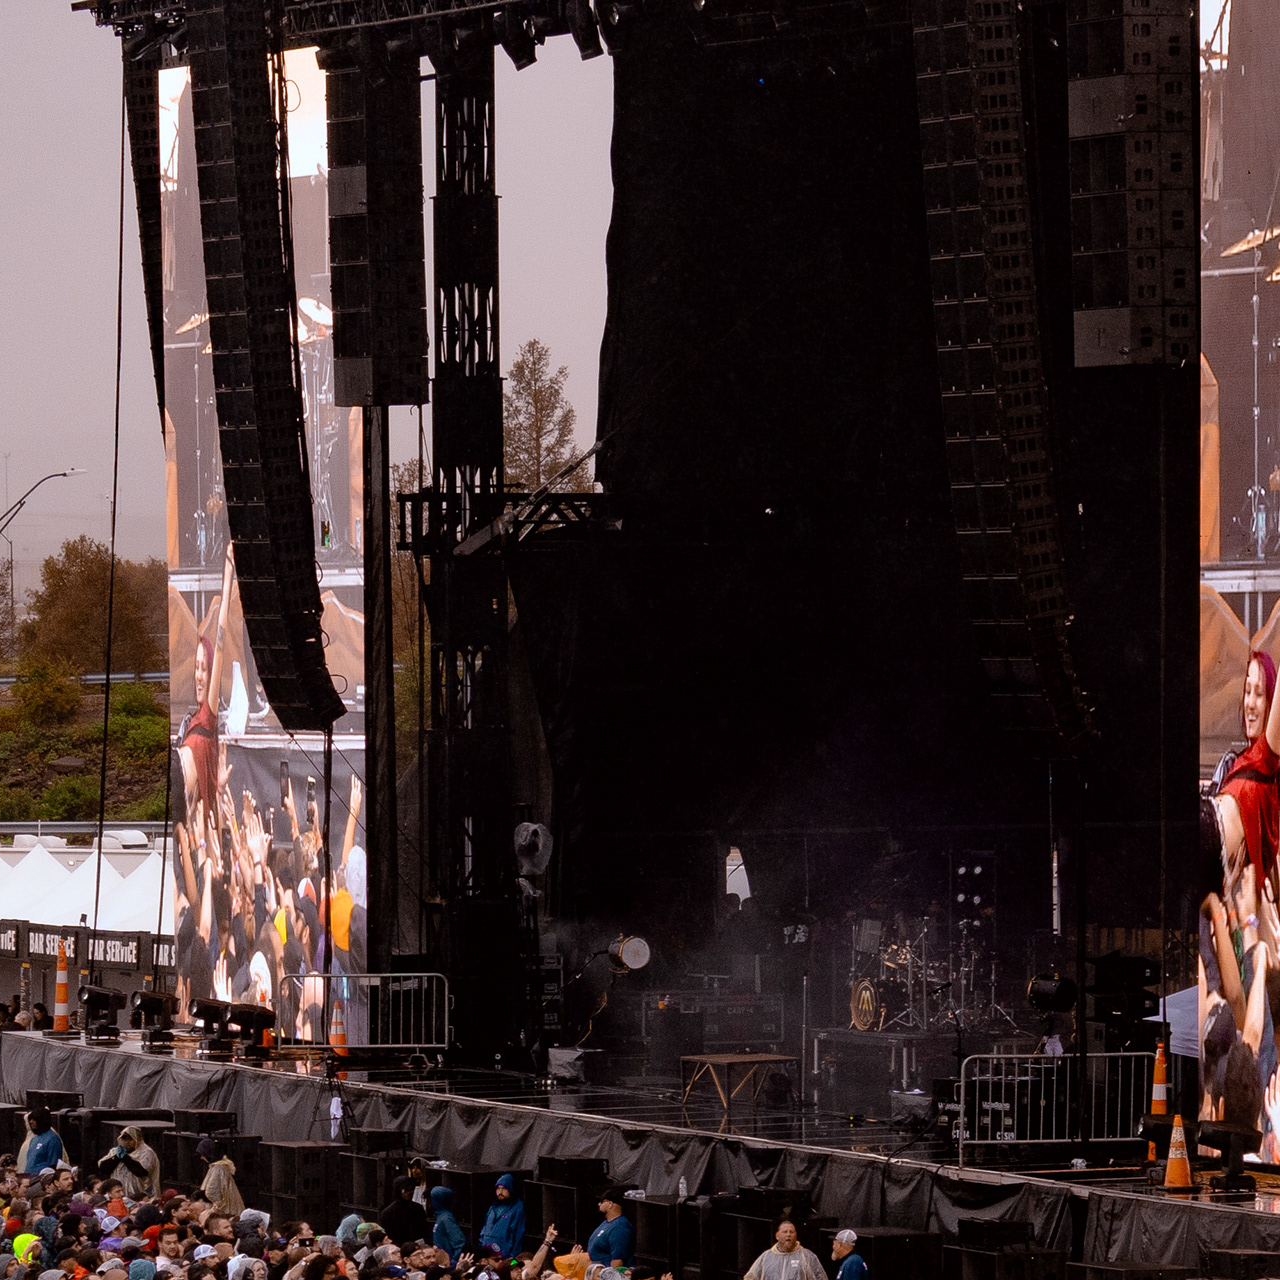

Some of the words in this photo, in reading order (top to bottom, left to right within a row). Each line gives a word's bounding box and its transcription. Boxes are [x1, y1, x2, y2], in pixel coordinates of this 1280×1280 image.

[29, 932, 44, 954] BAR
[45, 934, 75, 957] SERCE
[106, 940, 137, 963] SERVICE
